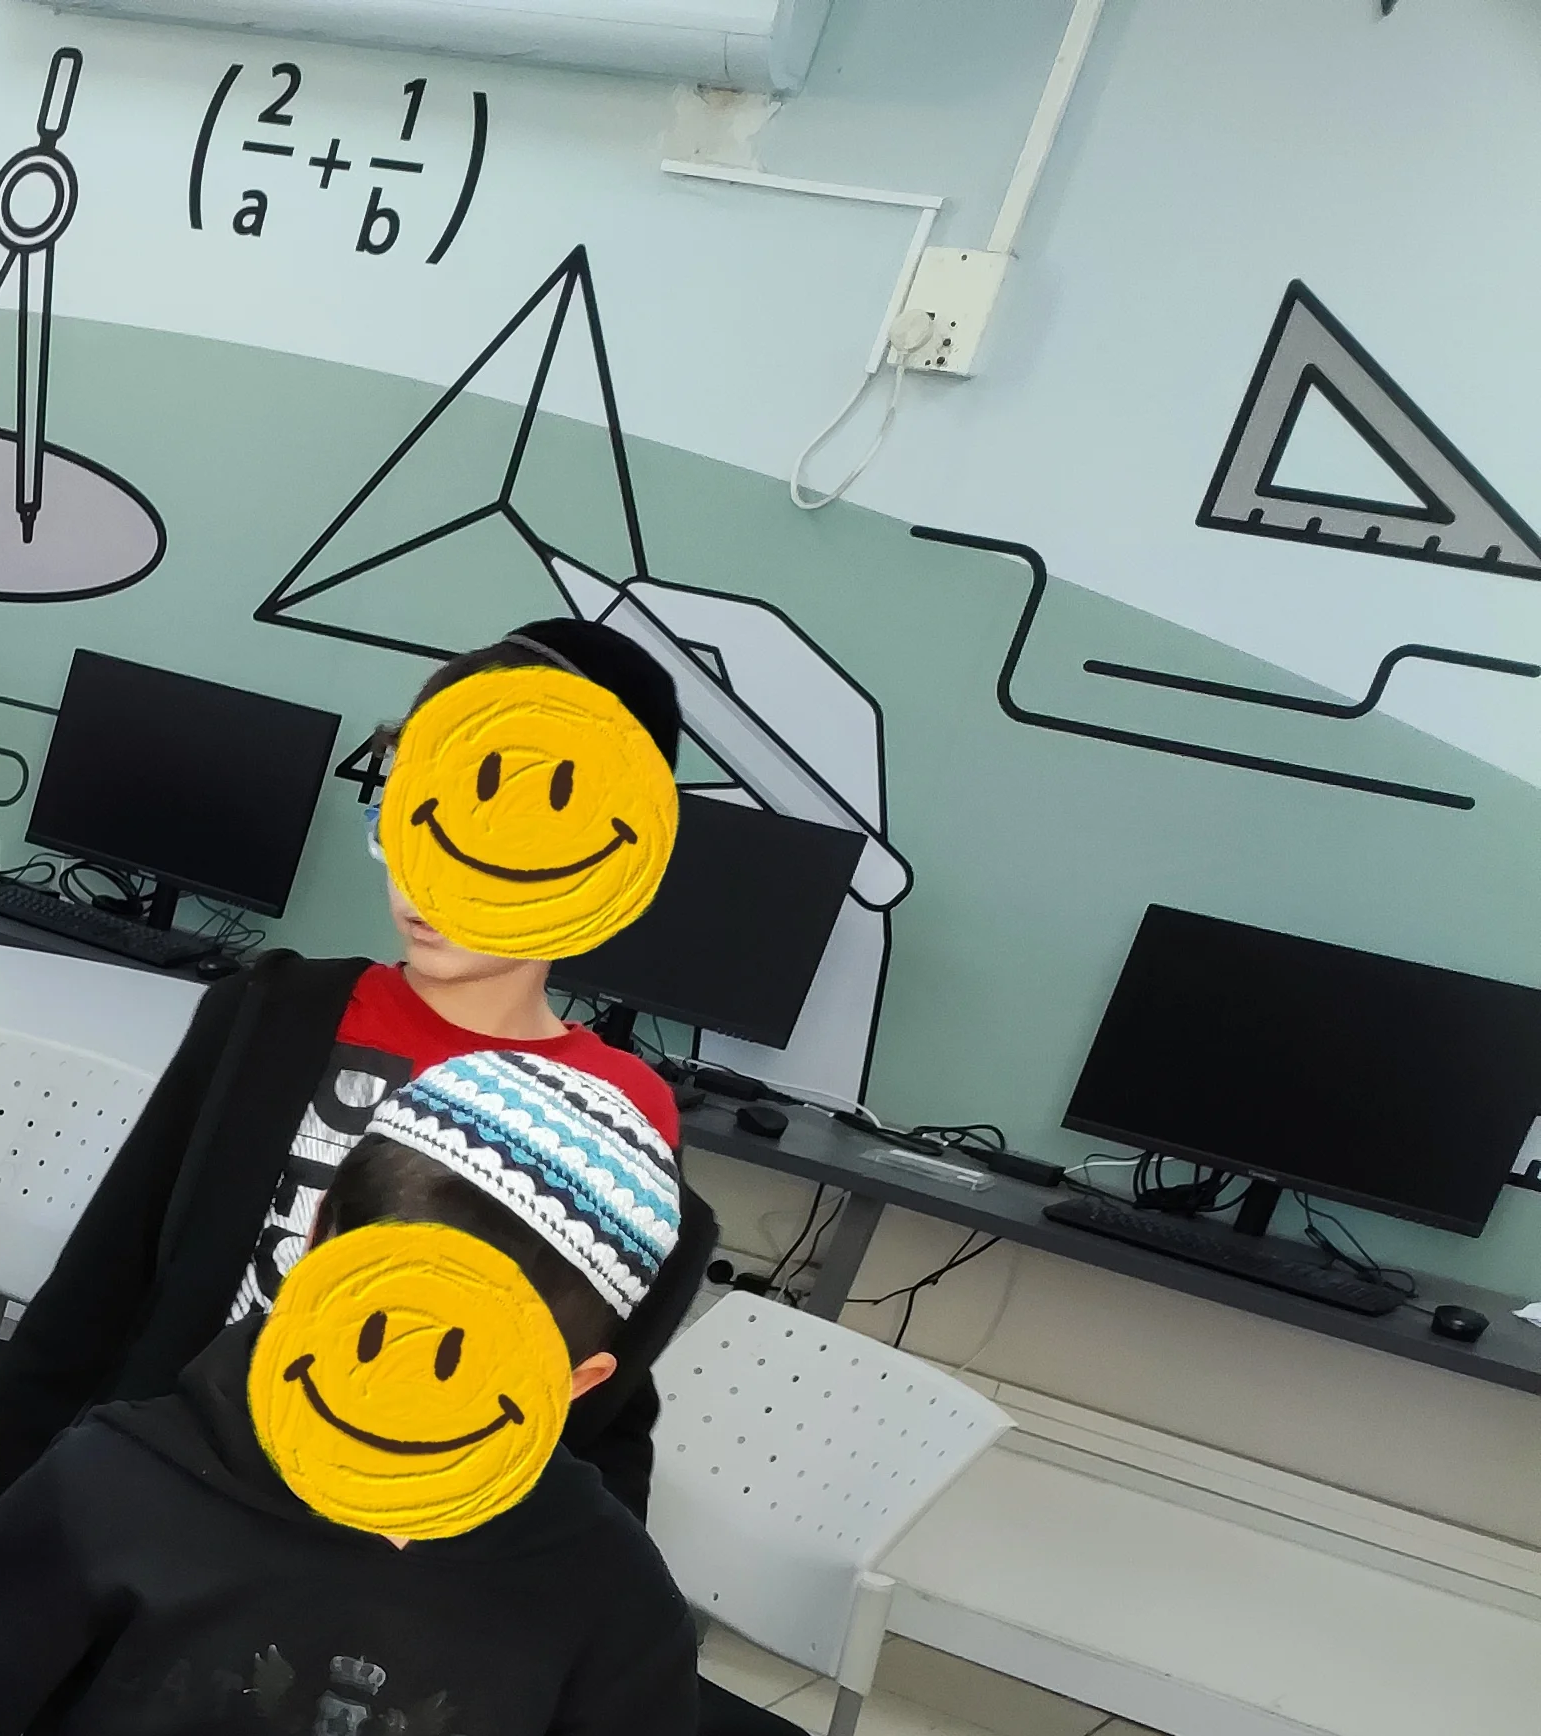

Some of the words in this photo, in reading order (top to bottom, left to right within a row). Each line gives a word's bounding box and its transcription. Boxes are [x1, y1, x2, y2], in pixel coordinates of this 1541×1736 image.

[258, 63, 302, 126] 2
[400, 78, 427, 141] 1
[232, 189, 268, 237] a
[355, 187, 401, 255] b
